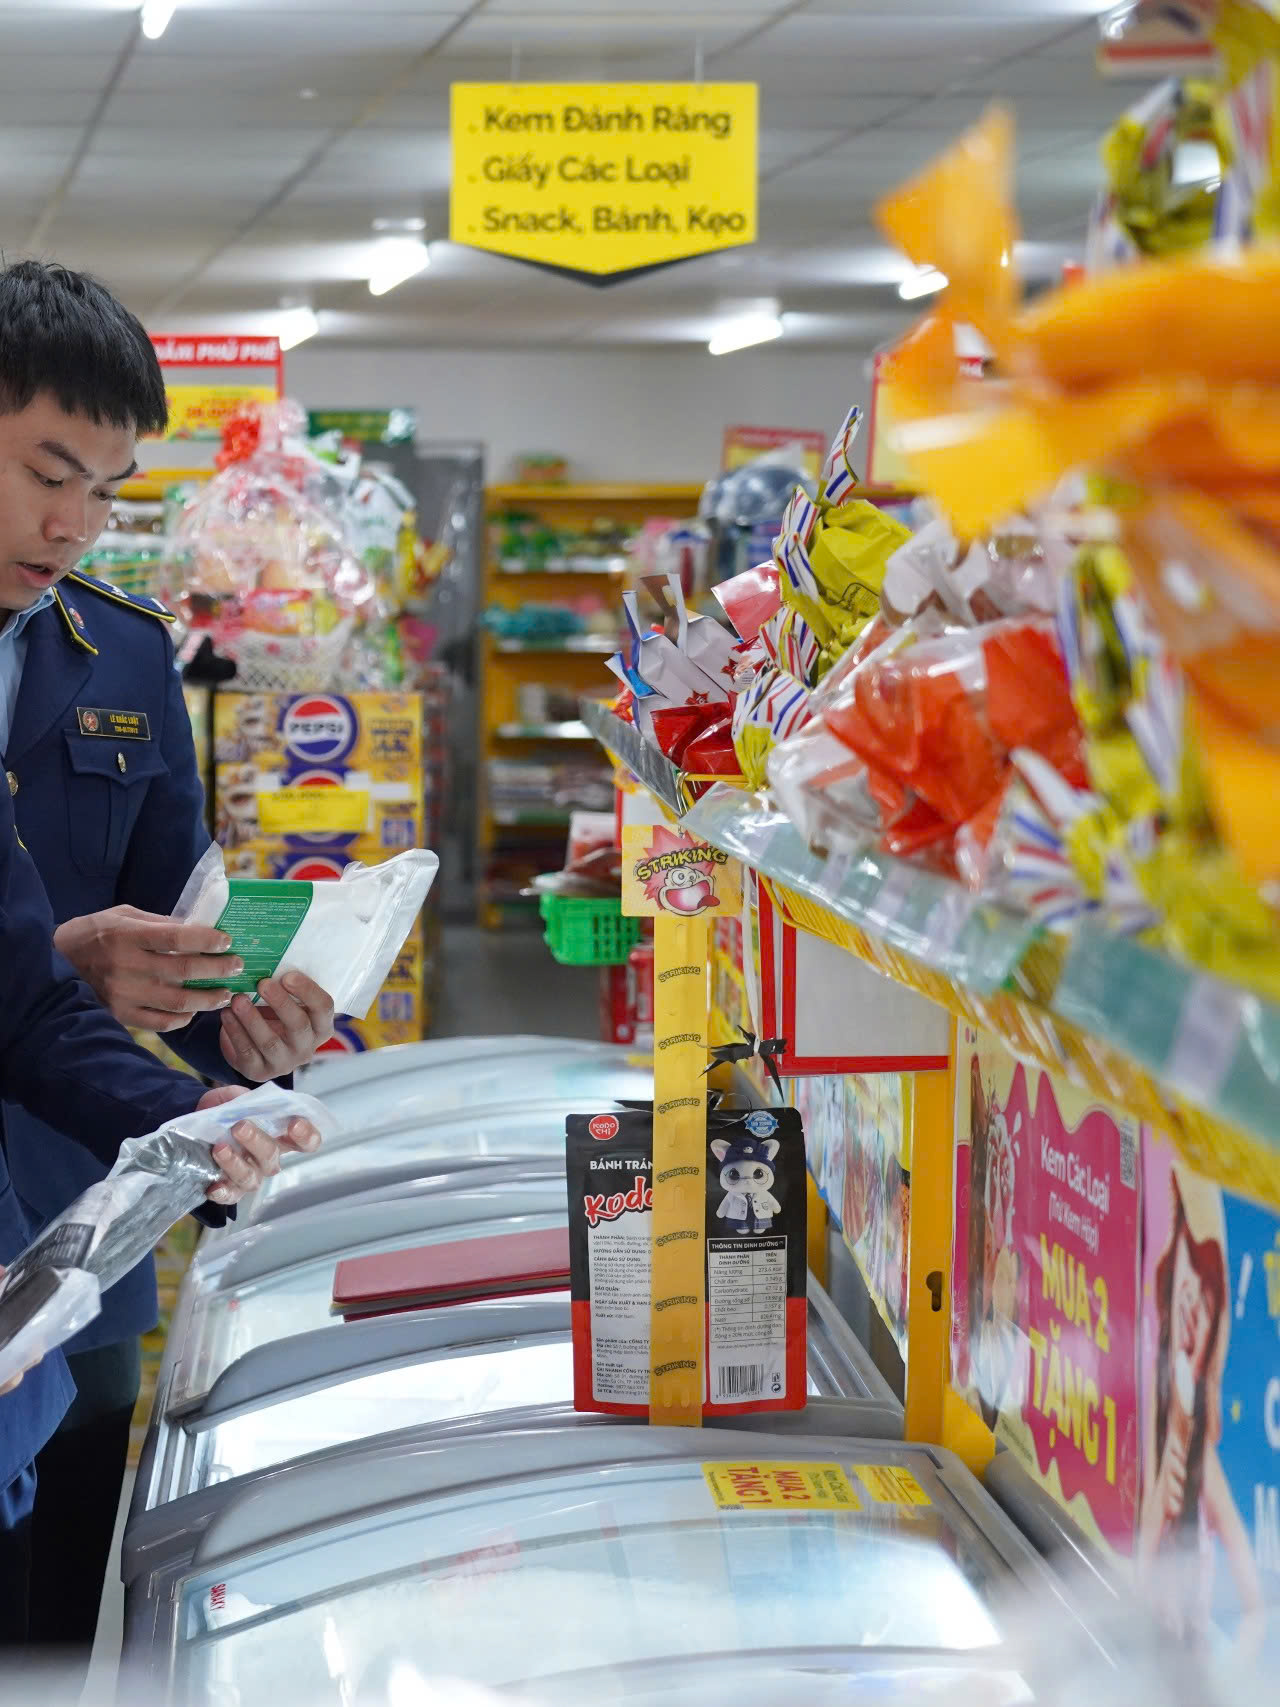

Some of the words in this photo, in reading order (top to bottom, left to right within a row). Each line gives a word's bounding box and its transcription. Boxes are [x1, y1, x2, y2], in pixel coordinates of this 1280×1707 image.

[483, 106, 555, 133] Kem
[563, 103, 644, 133] Đánh
[557, 152, 617, 182] Các
[625, 153, 692, 189] Loại
[686, 205, 747, 237] Kẹo
[289, 721, 344, 734] PEPSI
[634, 847, 729, 882] STRIKING
[658, 966, 701, 983] STRIKING
[658, 1034, 701, 1051] STRIKING
[657, 1098, 700, 1115] STRIKING
[590, 1157, 622, 1170] BÁNH
[625, 1157, 653, 1170] TRÁN
[657, 1167, 700, 1183] STRIKING
[655, 1231, 699, 1247] STRIKING
[1039, 1231, 1093, 1340] MUA
[1093, 1275, 1110, 1354] 2
[655, 1296, 698, 1311] STRIKING
[654, 1360, 697, 1376] STRIKING
[1029, 1316, 1100, 1467] TẶNG
[1103, 1393, 1117, 1487] 1
